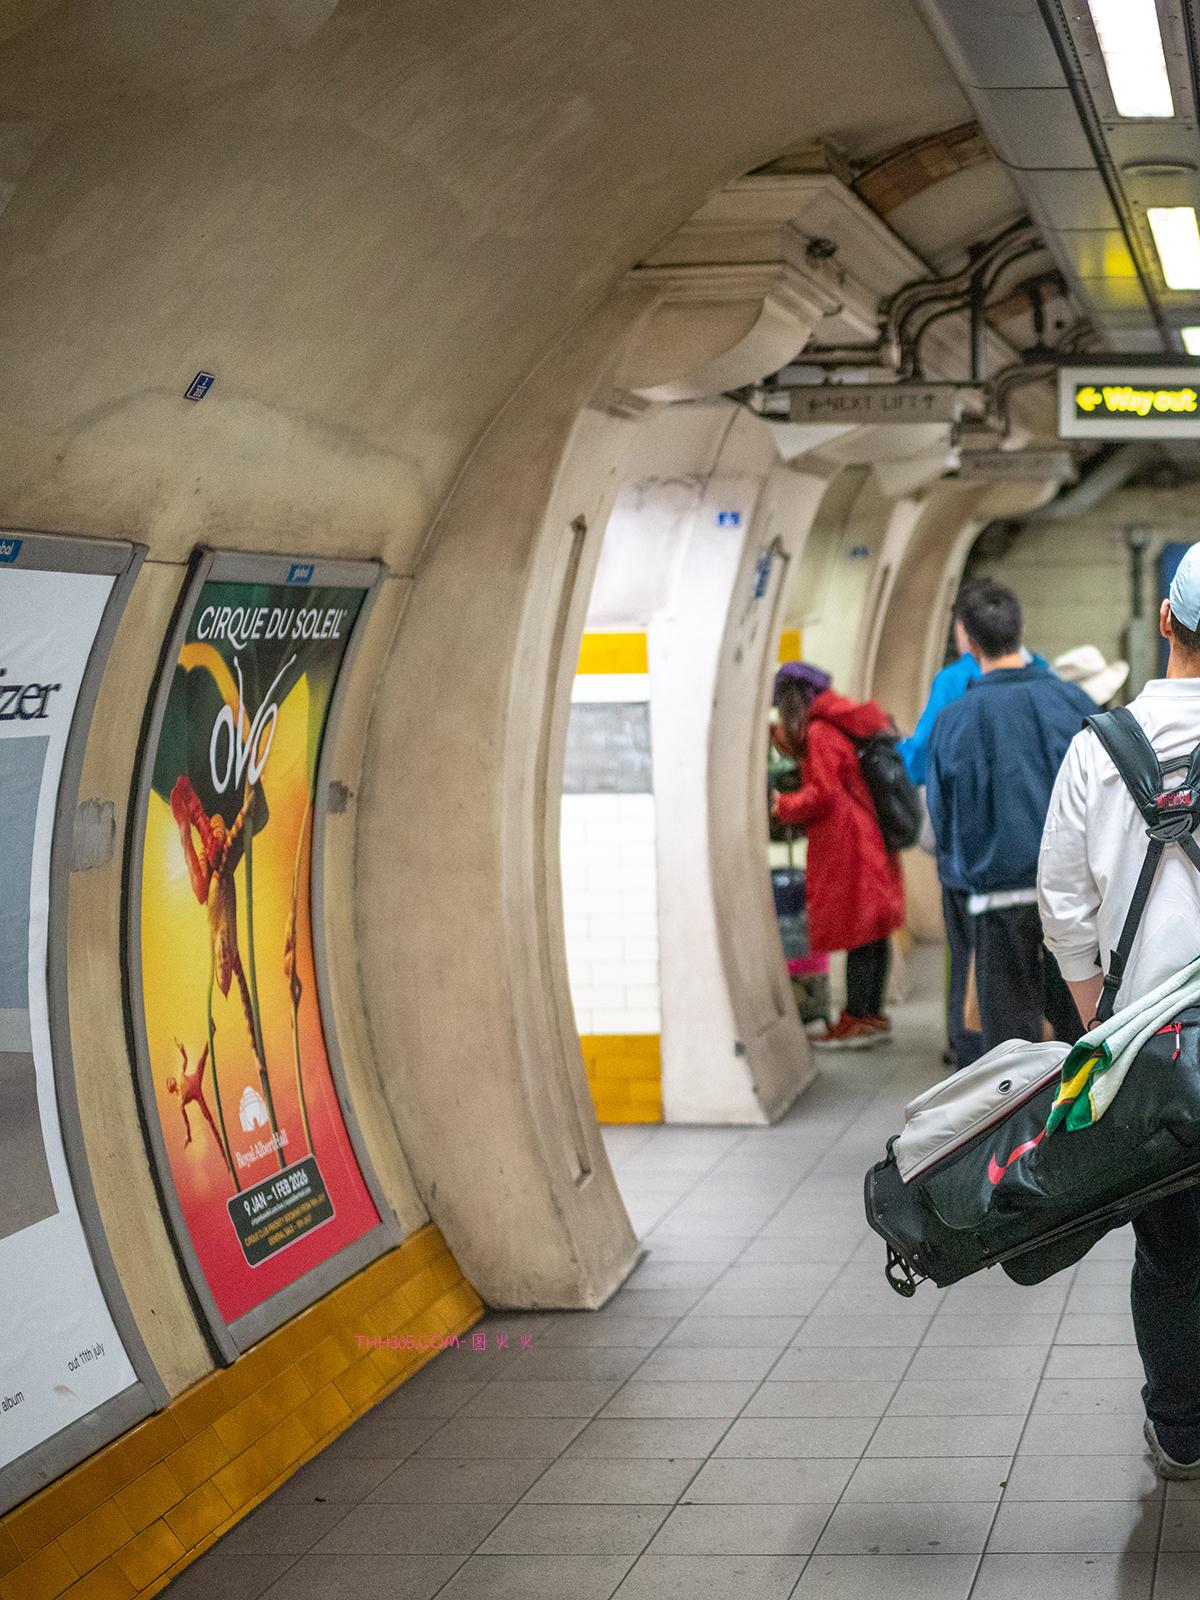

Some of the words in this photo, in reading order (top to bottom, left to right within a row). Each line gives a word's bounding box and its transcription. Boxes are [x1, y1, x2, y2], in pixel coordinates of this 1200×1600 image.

[826, 396, 872, 411] NEXT
[1103, 386, 1153, 415] Way
[1152, 388, 1197, 412] out
[197, 605, 269, 650] CIRQUE
[264, 607, 295, 641] DU
[291, 608, 344, 641] SOLEIL
[243, 1200, 251, 1217] 9
[250, 1191, 267, 1213] JAN
[276, 1176, 292, 1198] FEB
[289, 1168, 309, 1191] 2026
[67, 1356, 80, 1372] out
[79, 1349, 94, 1364] 11th
[92, 1342, 105, 1360] july
[1, 1391, 25, 1412] album
